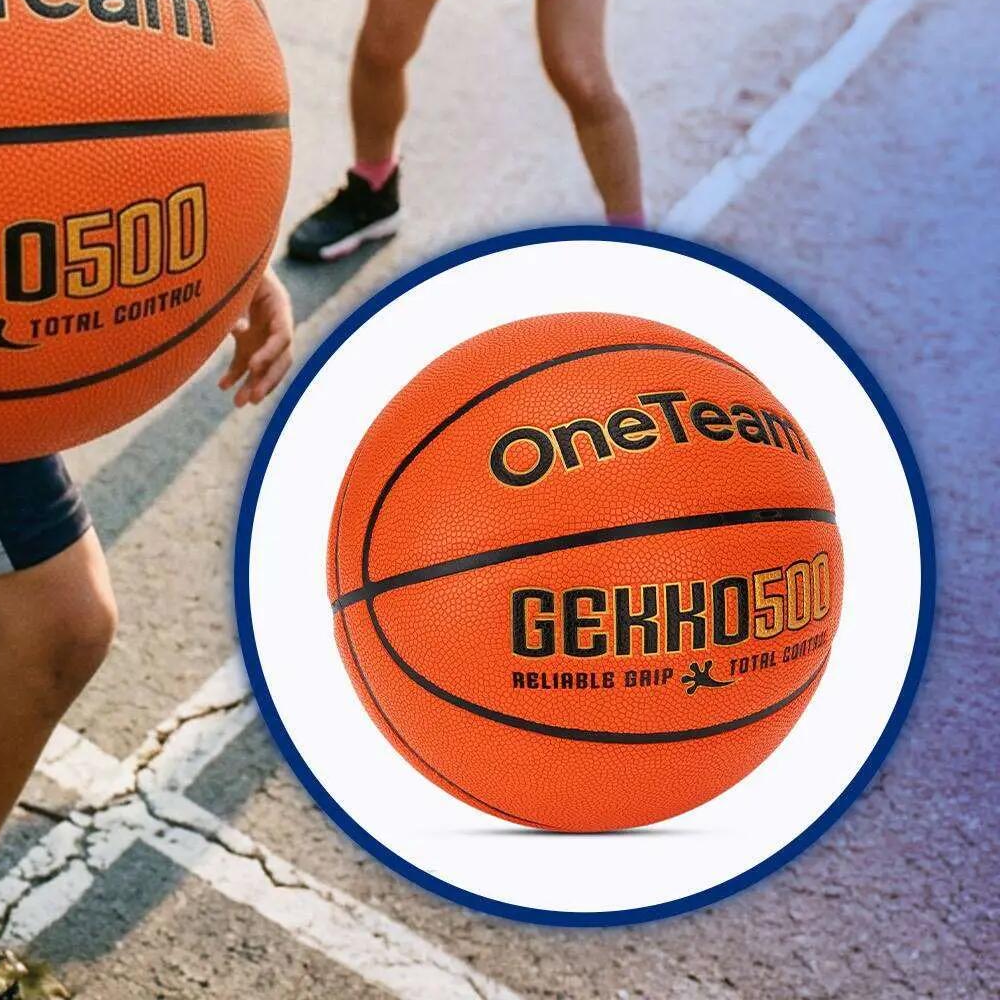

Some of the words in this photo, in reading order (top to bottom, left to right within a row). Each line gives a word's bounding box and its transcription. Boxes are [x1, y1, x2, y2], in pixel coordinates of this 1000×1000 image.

[29, 311, 105, 337] TOTAL
[114, 279, 202, 325] CONTROL
[488, 390, 811, 487] OneTeam
[512, 669, 615, 690] RELIABLE
[624, 667, 674, 688] GRIP
[729, 650, 777, 677] TOTAL
